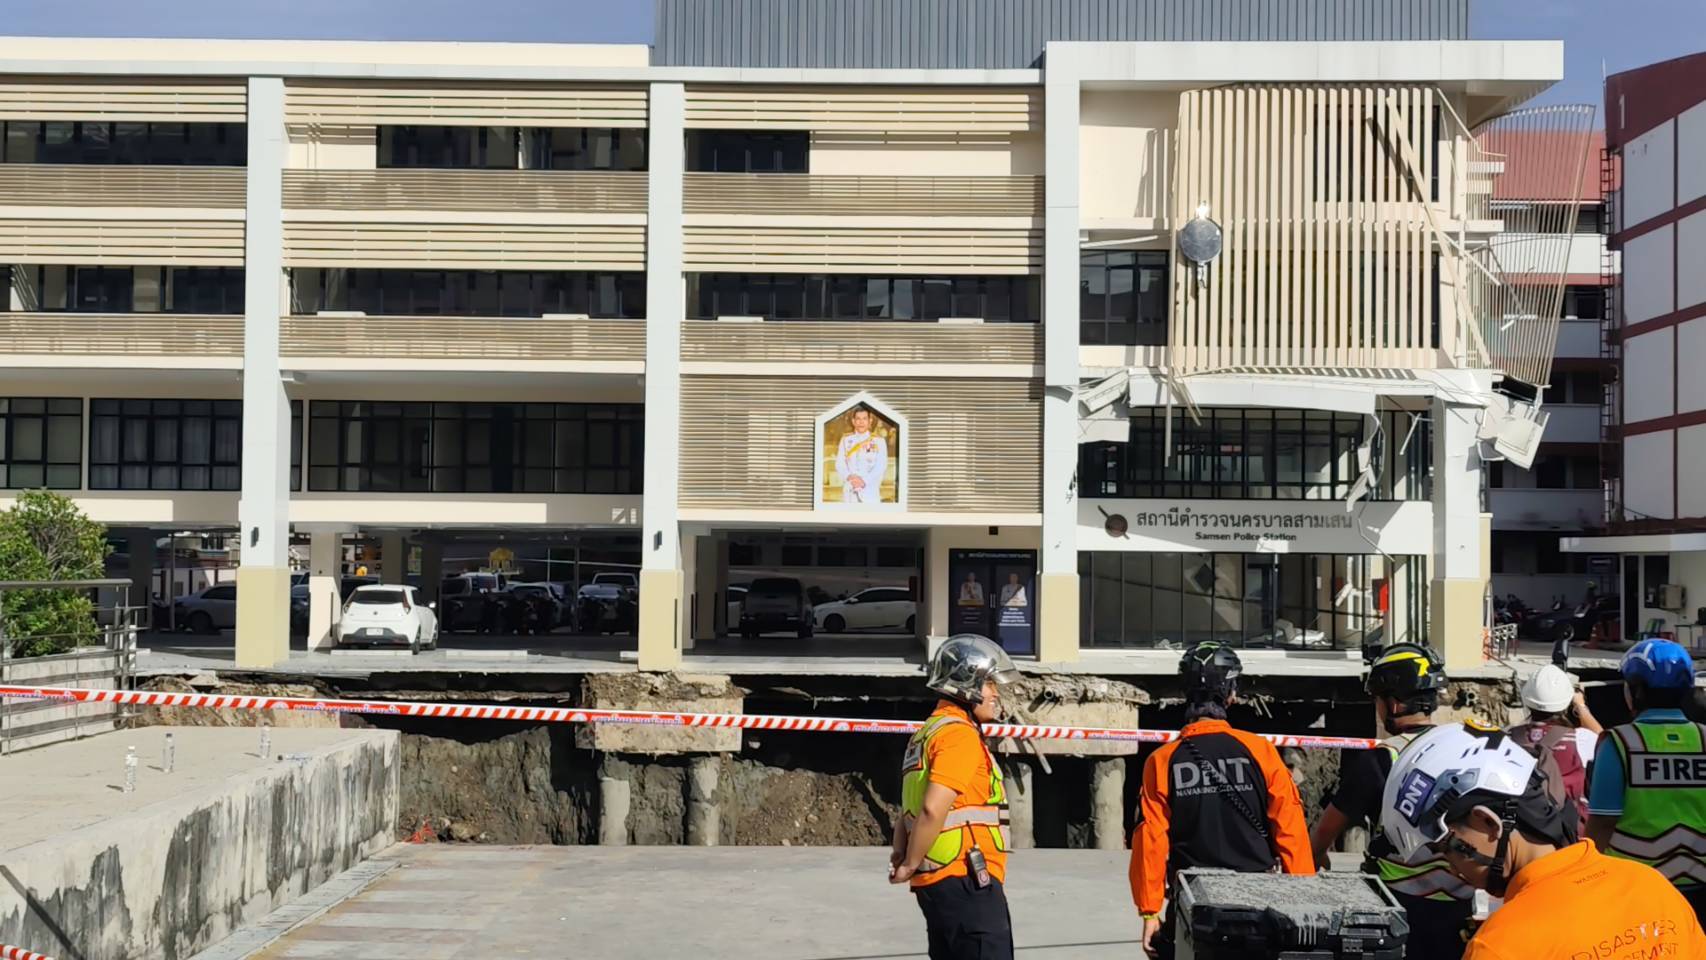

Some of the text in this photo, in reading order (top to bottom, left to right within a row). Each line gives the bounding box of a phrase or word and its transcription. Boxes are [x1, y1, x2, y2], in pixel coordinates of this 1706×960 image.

[1136, 507, 1353, 529] สถานีตำรวจนครบาลสามเสน
[1195, 532, 1297, 542] Samsen Police Station
[1173, 757, 1250, 790] DNT
[1643, 758, 1706, 780] FIRE
[1400, 774, 1427, 817] DNT
